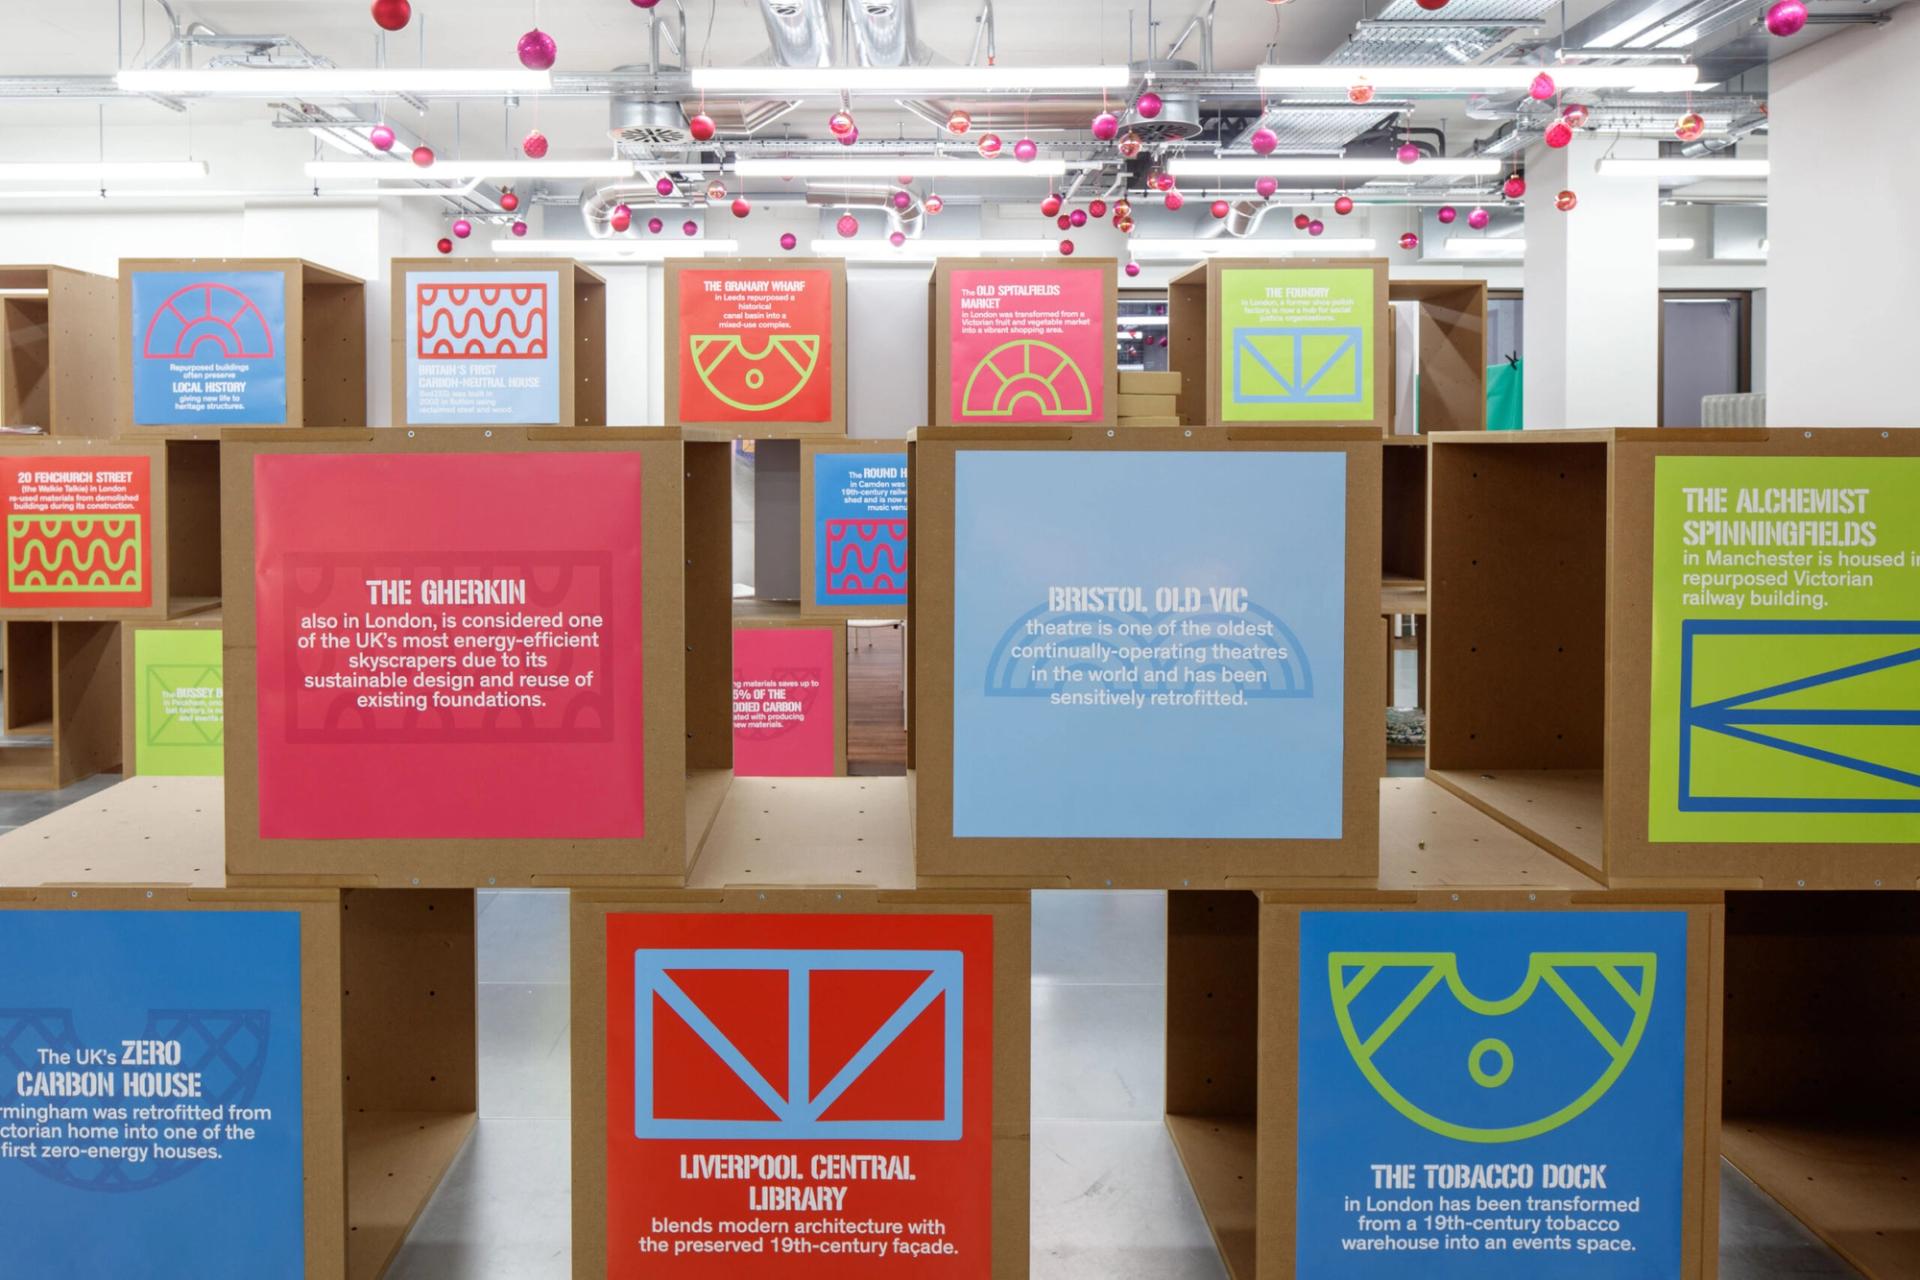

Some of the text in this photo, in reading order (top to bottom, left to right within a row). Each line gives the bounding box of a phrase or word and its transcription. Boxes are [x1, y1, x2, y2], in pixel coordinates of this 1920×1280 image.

[704, 281, 805, 291] THE GRANARY WHARF
[976, 285, 995, 296] OLD
[998, 285, 1060, 296] SPITALFIELDS
[961, 298, 1000, 308] MARKET
[18, 472, 133, 483] 20 FENCHURCH STREET
[863, 468, 897, 478] ROUND
[1682, 487, 1870, 514] THE ALCHEMIST
[1683, 520, 1876, 546] SPINNINGFIELDS
[1683, 550, 1700, 566] in
[1706, 549, 1813, 566] Manchester
[1818, 550, 1833, 567] is
[1838, 551, 1905, 567] housed
[1682, 570, 1873, 590] repurposed Victorian
[366, 579, 525, 605] THE GHERKIN
[1049, 586, 1248, 613] BRISTOL OLD VIC
[1682, 590, 1828, 610] railway building.
[301, 612, 603, 631] also in London, is considered one
[1025, 618, 1274, 637] theatre is one of the oldest
[298, 632, 316, 648] of
[320, 632, 350, 648] the
[403, 632, 449, 648] most
[454, 631, 599, 651] energy-efficient
[1011, 642, 1288, 662] continually-operating theatres
[357, 691, 546, 711] existing foundations.
[753, 689, 765, 700] OF
[768, 689, 786, 699] THE
[1050, 689, 1248, 709] sensitively retrofitted.
[763, 702, 801, 712] CARBON
[37, 1048, 70, 1065] The
[121, 1040, 181, 1065] ZERO
[17, 1071, 201, 1097] CARBON HOUSE
[93, 1108, 127, 1120] was
[133, 1104, 223, 1120] retrofitted
[228, 1104, 271, 1120] from
[1, 1142, 222, 1162] first zero-energy houses.
[680, 1154, 916, 1180] LIVERPOOL CENTRAL
[1371, 1164, 1607, 1189] THE TOBACCO DOCK
[750, 1186, 848, 1211] LIBRARY
[1345, 1195, 1640, 1212] in London has been transformed
[652, 1217, 945, 1235] blends modern architecture with
[1358, 1215, 1620, 1234] from a 19th-century tobacco
[638, 1236, 958, 1257] the preserved 19th-century façade.
